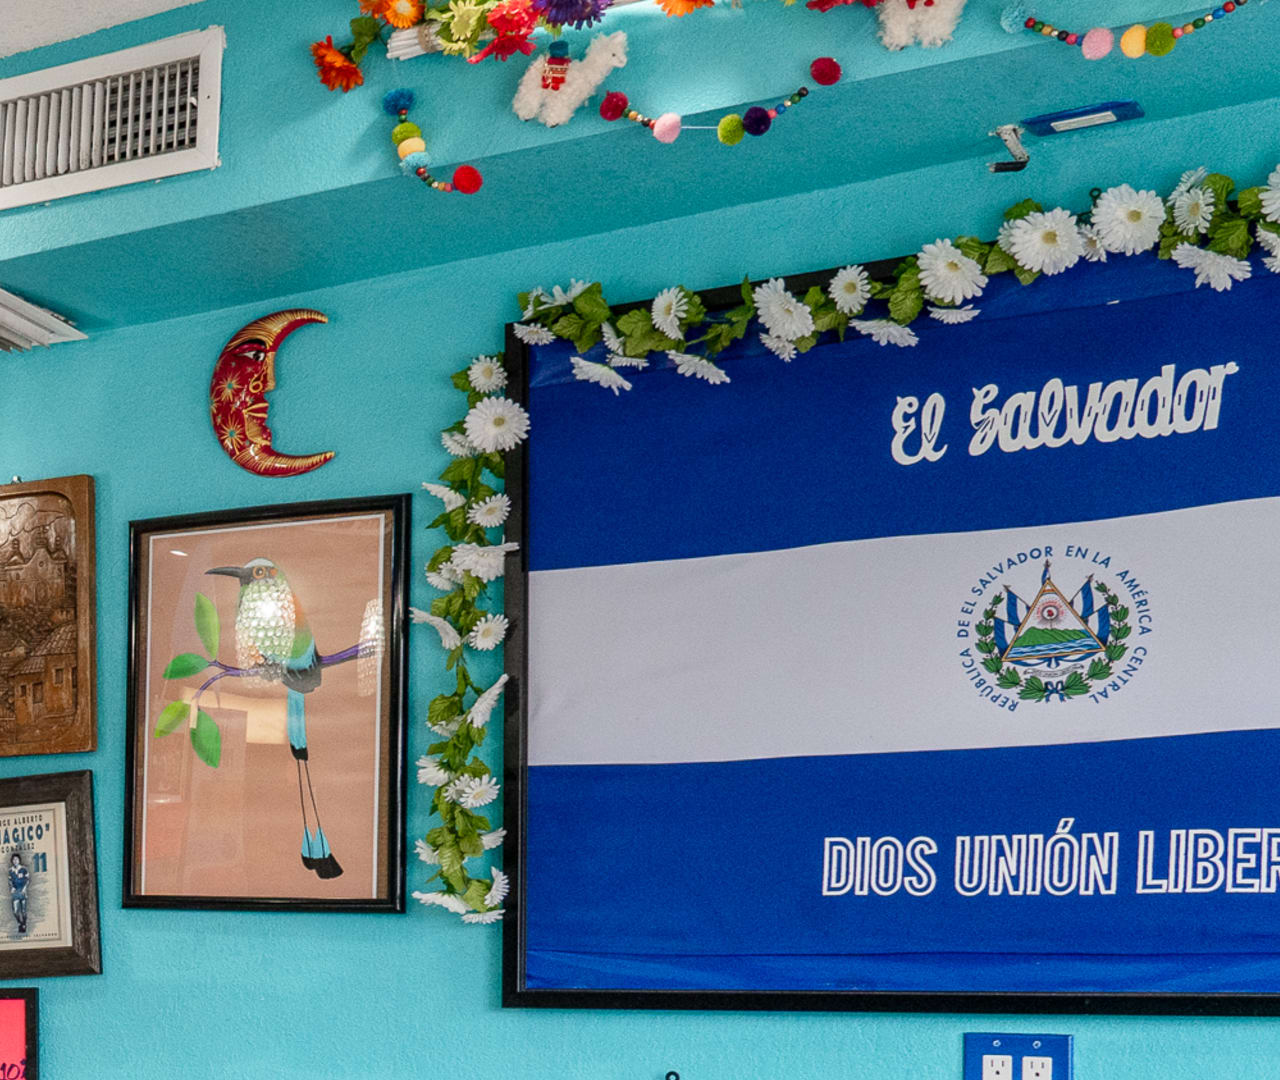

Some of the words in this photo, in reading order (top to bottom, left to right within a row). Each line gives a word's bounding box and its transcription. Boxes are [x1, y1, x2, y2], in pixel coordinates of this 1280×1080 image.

[891, 392, 947, 466] El
[969, 362, 1239, 456] Salvador
[1065, 545, 1088, 559] EN
[1091, 551, 1111, 569] LA
[971, 546, 1053, 596] SALVADOR
[961, 600, 977, 615] EL
[1116, 569, 1152, 636] AMÉRICA
[957, 620, 970, 638] DE
[960, 648, 1020, 712] REPÚBLICA
[1088, 646, 1147, 704] CENTRAL
[14, 815, 43, 825] ALBERTO
[32, 852, 47, 872] 11
[822, 836, 938, 896] DIOS
[954, 817, 1119, 896] UNIÓN
